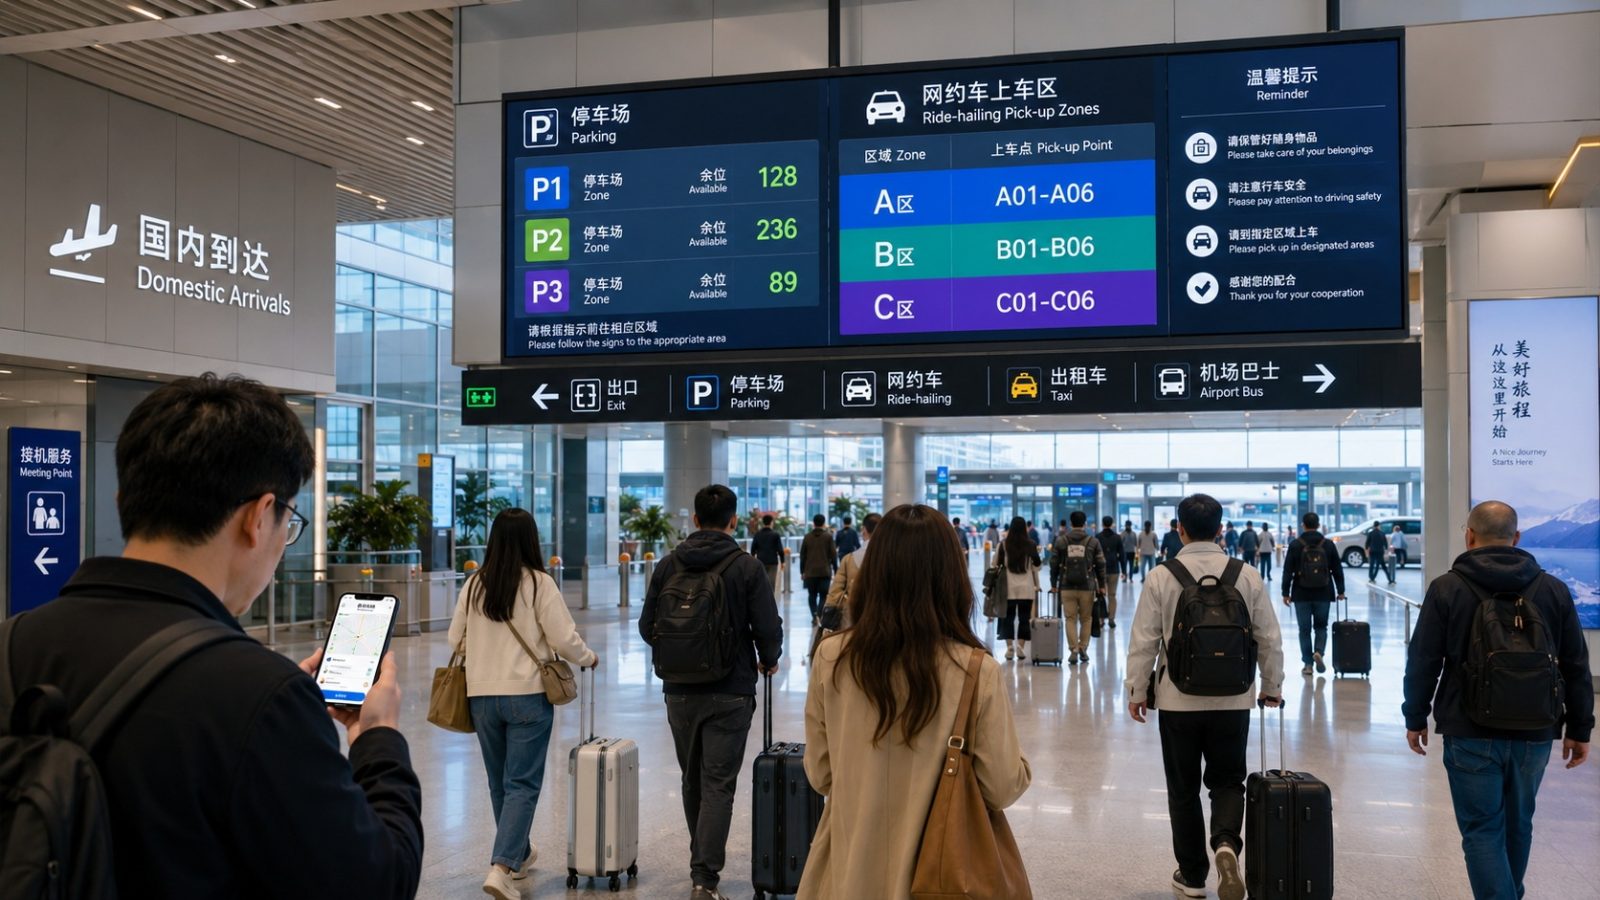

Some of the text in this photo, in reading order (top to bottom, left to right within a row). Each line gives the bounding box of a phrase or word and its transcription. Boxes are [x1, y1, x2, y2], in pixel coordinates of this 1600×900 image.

[1247, 67, 1318, 86] 温馨提示
[923, 78, 1057, 106] 网约车上车区
[1257, 89, 1309, 101] Reminder
[572, 104, 630, 127] 停车场
[923, 103, 1100, 124] Ride-hailing Pick-up Zones
[572, 132, 617, 145] Parking
[865, 149, 926, 163] 区域 Zone
[990, 140, 1113, 157] 上车点 Pick-up Point
[1228, 151, 1254, 160] Please
[1257, 150, 1274, 158] take
[1296, 148, 1305, 156] of
[1306, 148, 1325, 157] your
[1327, 145, 1373, 155] belongings
[584, 173, 623, 188] 停车场
[700, 168, 726, 183] 余位
[759, 165, 797, 188] 128
[533, 176, 561, 201] P1
[689, 184, 727, 194] Available
[1228, 179, 1306, 194] 请注意行车安全
[584, 190, 610, 201] Zone
[874, 189, 914, 214] A区
[995, 183, 1094, 207] A01-A06
[1229, 198, 1255, 206] Please
[1257, 198, 1272, 207] pay
[1274, 195, 1312, 205] attention
[1325, 193, 1354, 203] driving
[1356, 192, 1382, 202] safety
[584, 225, 623, 240] 停车场
[700, 221, 726, 235] 余位
[757, 218, 797, 240] 236
[1229, 226, 1318, 241] 请到指定区域上车
[140, 214, 270, 281] 国内到达
[533, 229, 563, 253] P2
[584, 242, 610, 253] Zone
[689, 237, 727, 247] Available
[997, 236, 1095, 260] B01-B06
[1229, 245, 1256, 254] Please
[1258, 244, 1276, 254] pick
[1278, 245, 1289, 253] up
[1300, 241, 1349, 252] designated
[875, 242, 915, 267] B区
[584, 277, 623, 291] 停车场
[700, 273, 726, 287] 余位
[770, 271, 797, 293] 89
[1229, 274, 1296, 288] 感谢您的配合
[137, 266, 291, 316] Domestic Arrivals
[533, 280, 563, 303] P3
[689, 289, 727, 299] Available
[1230, 288, 1364, 302] Thank you for your cooperation
[584, 294, 610, 305] Zone
[874, 294, 915, 320] C区
[996, 290, 1095, 313] C01-C06
[529, 335, 726, 350] Please follow the signs to the appropriate area
[888, 370, 943, 389] 网约车
[1050, 366, 1107, 386] 出租车
[1200, 361, 1280, 383] 机场巴士
[1512, 340, 1531, 418] 美好旅程
[608, 379, 638, 397] 出口
[730, 375, 784, 394] 停车场
[1200, 384, 1264, 400] Airport Bus
[887, 392, 952, 406] Ride-hailing
[1050, 390, 1073, 401] Taxi
[608, 400, 626, 411] Exit
[731, 398, 770, 410] Parking
[21, 446, 72, 464] 接机服务
[1517, 449, 1547, 457] Journey
[20, 468, 72, 479] Meeting Point
